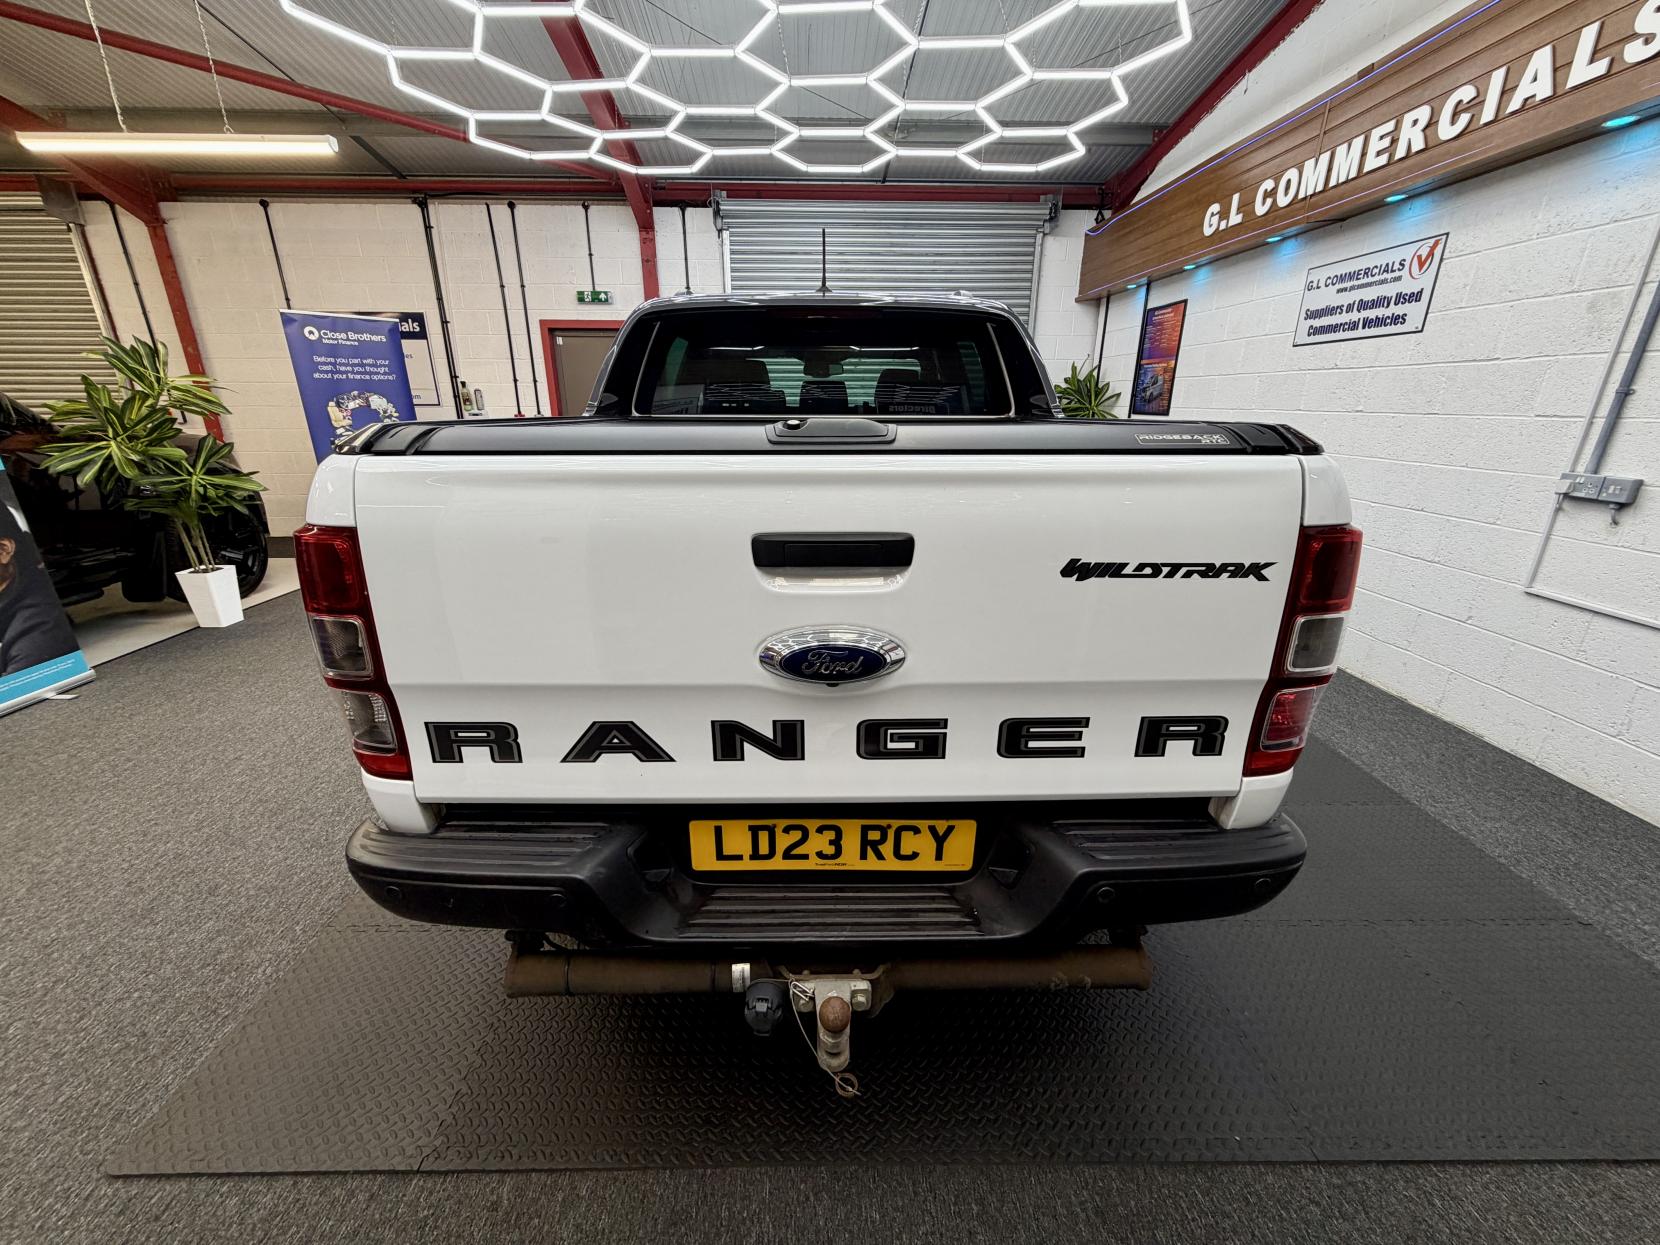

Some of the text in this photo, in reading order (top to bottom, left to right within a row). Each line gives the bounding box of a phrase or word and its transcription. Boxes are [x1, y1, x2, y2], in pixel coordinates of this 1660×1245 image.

[1203, 0, 1660, 237] G.L COMMERCIALS
[1306, 259, 1406, 292] G.L COMMERCIALS
[1304, 288, 1424, 321] Suppliers of Quality Used
[320, 329, 386, 342] Close Brothers
[1306, 312, 1408, 338] Commercial Vehicles
[313, 355, 334, 363] Before
[365, 366, 390, 374] thought
[1060, 558, 1279, 582] WILDTRAK
[801, 649, 864, 675] Ford
[424, 716, 1230, 764] RANGER
[714, 824, 956, 862] LD23 RCY
